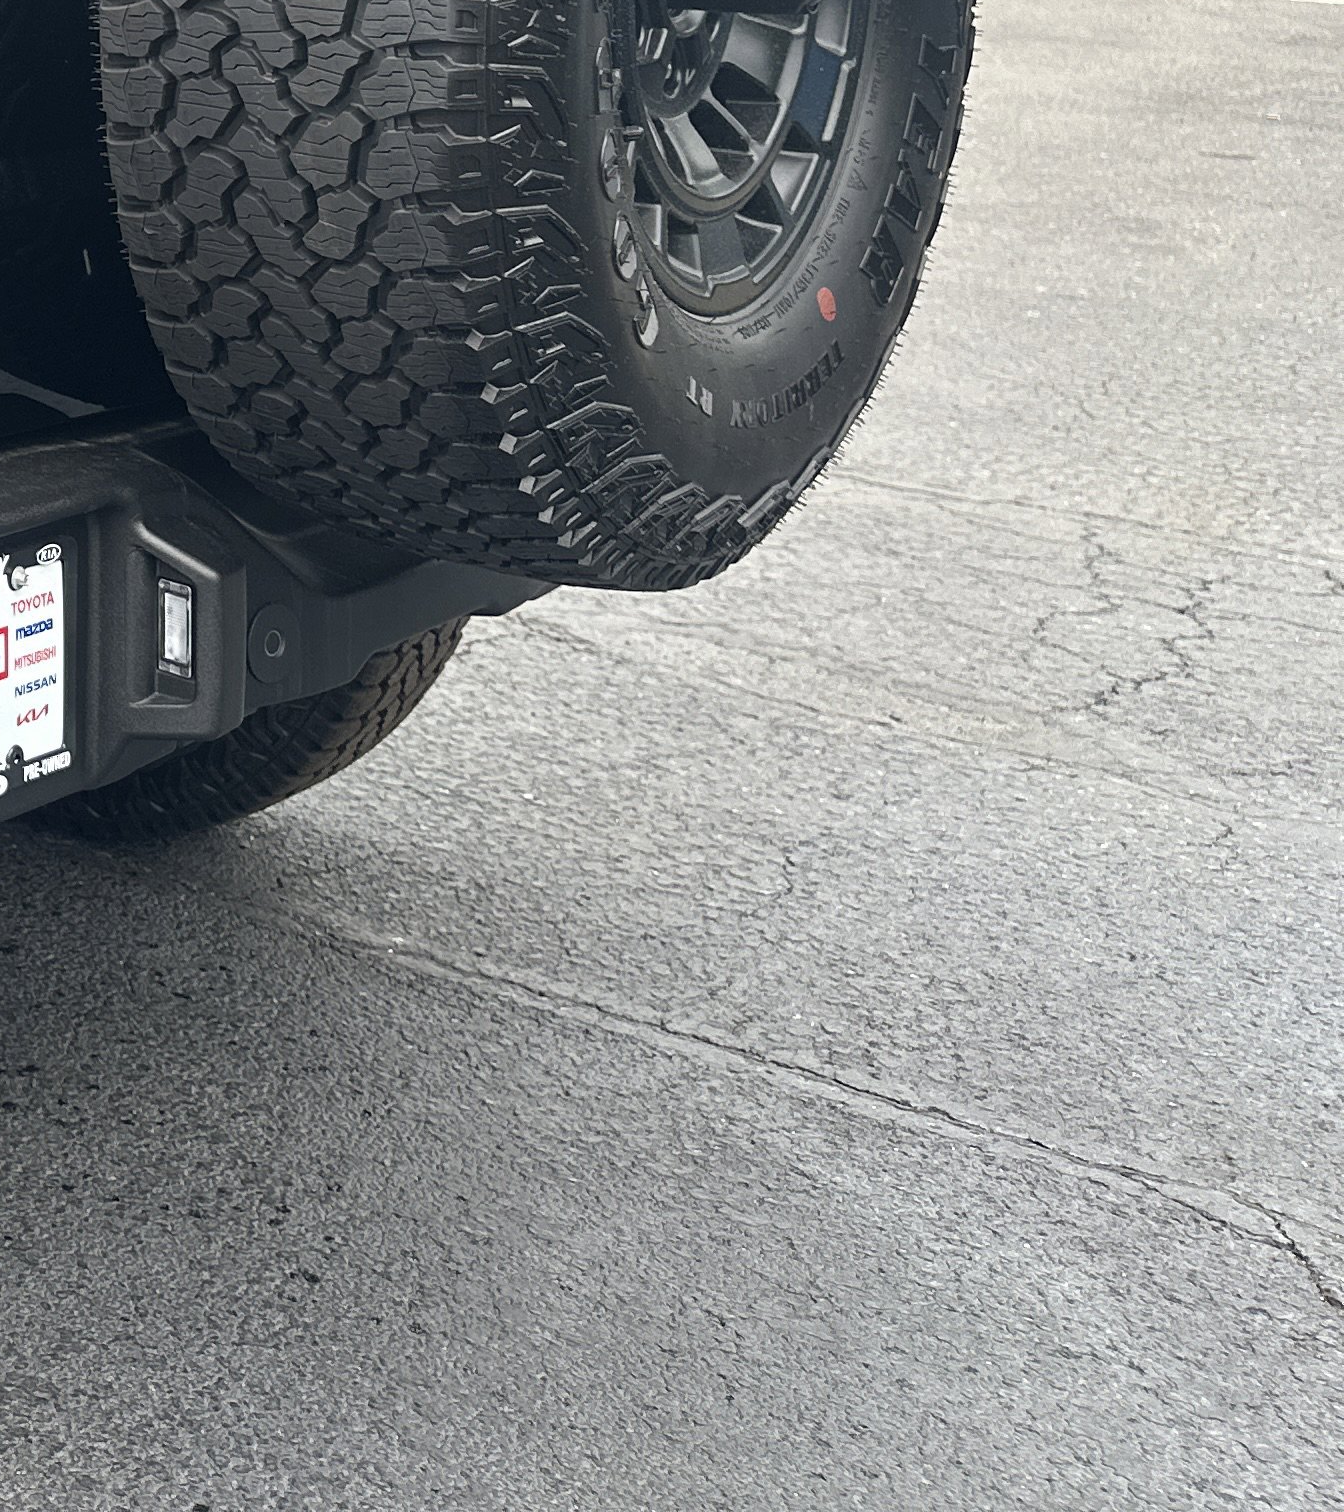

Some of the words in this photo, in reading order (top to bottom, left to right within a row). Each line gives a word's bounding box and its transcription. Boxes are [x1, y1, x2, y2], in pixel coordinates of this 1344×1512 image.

[11, 591, 54, 616] TOYOTA
[14, 645, 57, 670] MITSUBISHI
[14, 674, 57, 697] NISSAN
[23, 751, 71, 782] PRE-OWNED
